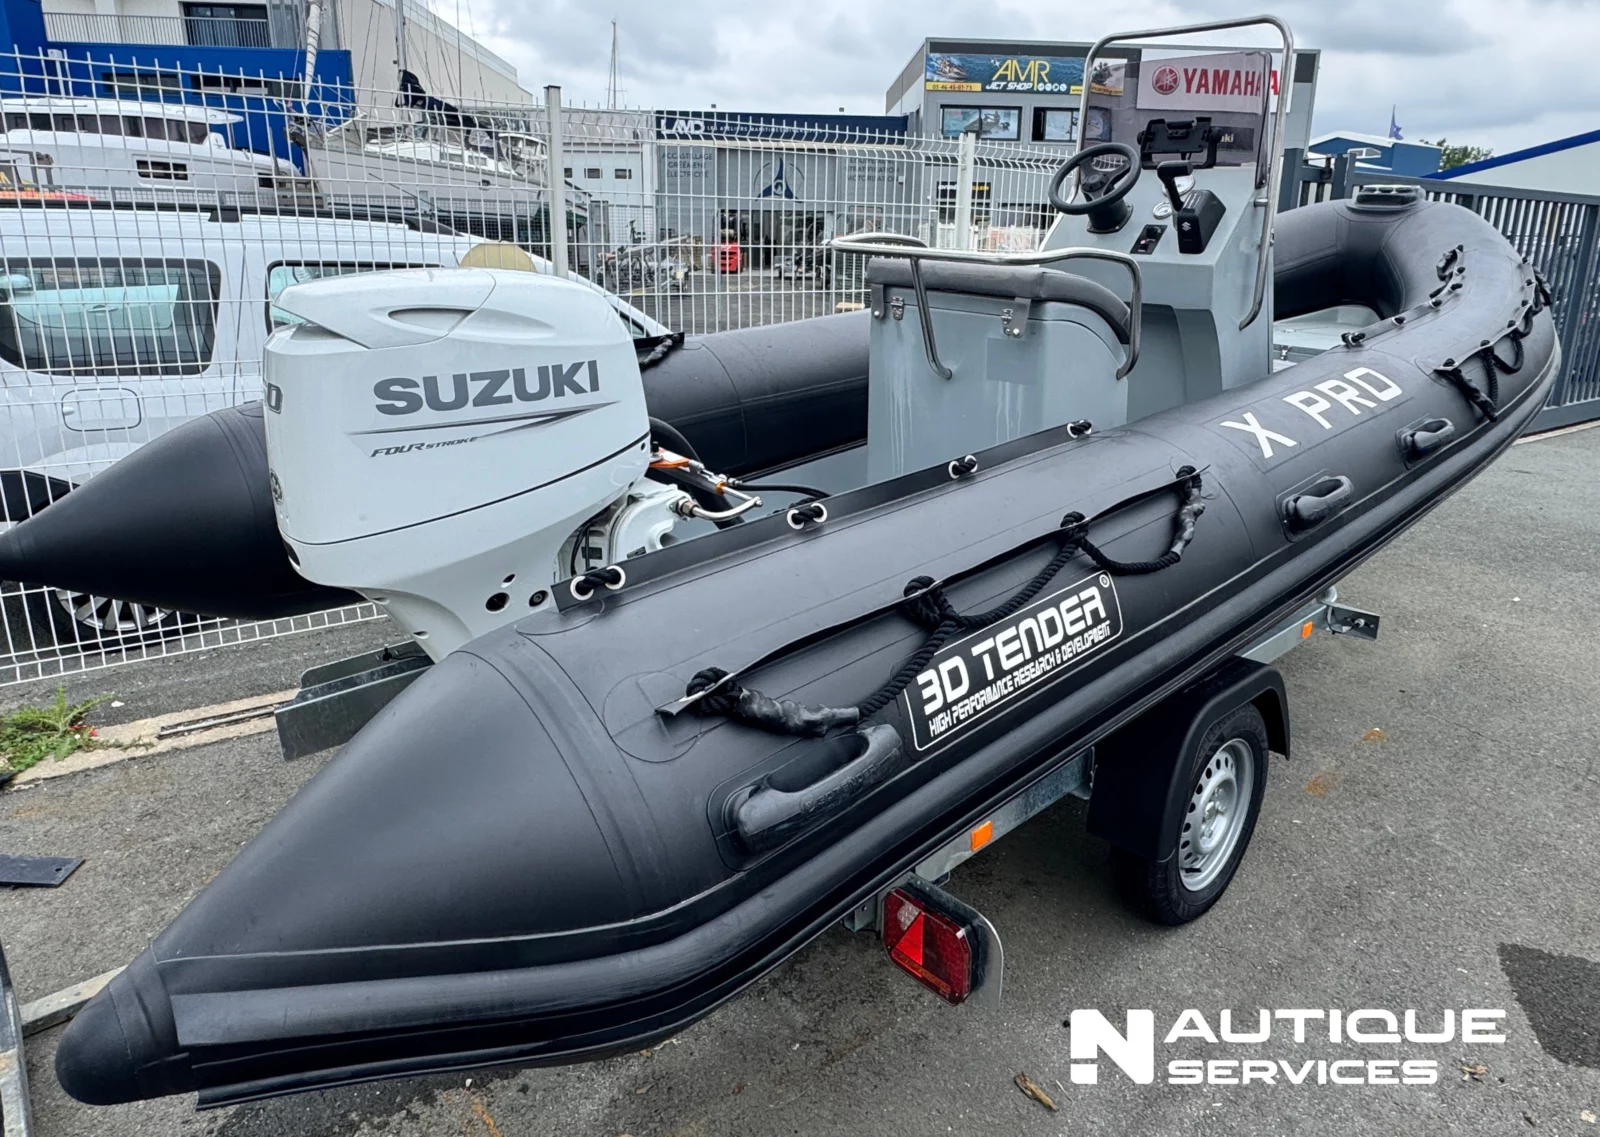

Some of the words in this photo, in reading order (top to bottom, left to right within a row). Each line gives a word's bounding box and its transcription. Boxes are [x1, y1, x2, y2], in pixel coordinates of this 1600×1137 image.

[986, 82, 1006, 90] JET
[1007, 82, 1033, 91] SHOP
[992, 59, 1049, 90] AMR
[1183, 68, 1279, 96] YAMAHA
[662, 153, 712, 161] ACCSTLLAGE
[373, 360, 600, 416] SUZUKI
[1219, 411, 1298, 459] X
[1282, 366, 1403, 430] PRO
[370, 442, 425, 458] FOUR
[424, 436, 481, 450] STROKE
[916, 655, 970, 716] 3D
[971, 586, 1106, 681] TENDER
[928, 709, 952, 737] HIGH
[952, 676, 1014, 724] PERFORMANCE
[1014, 652, 1055, 688] RESEARCH
[1062, 620, 1111, 659] DEVELOPMENT
